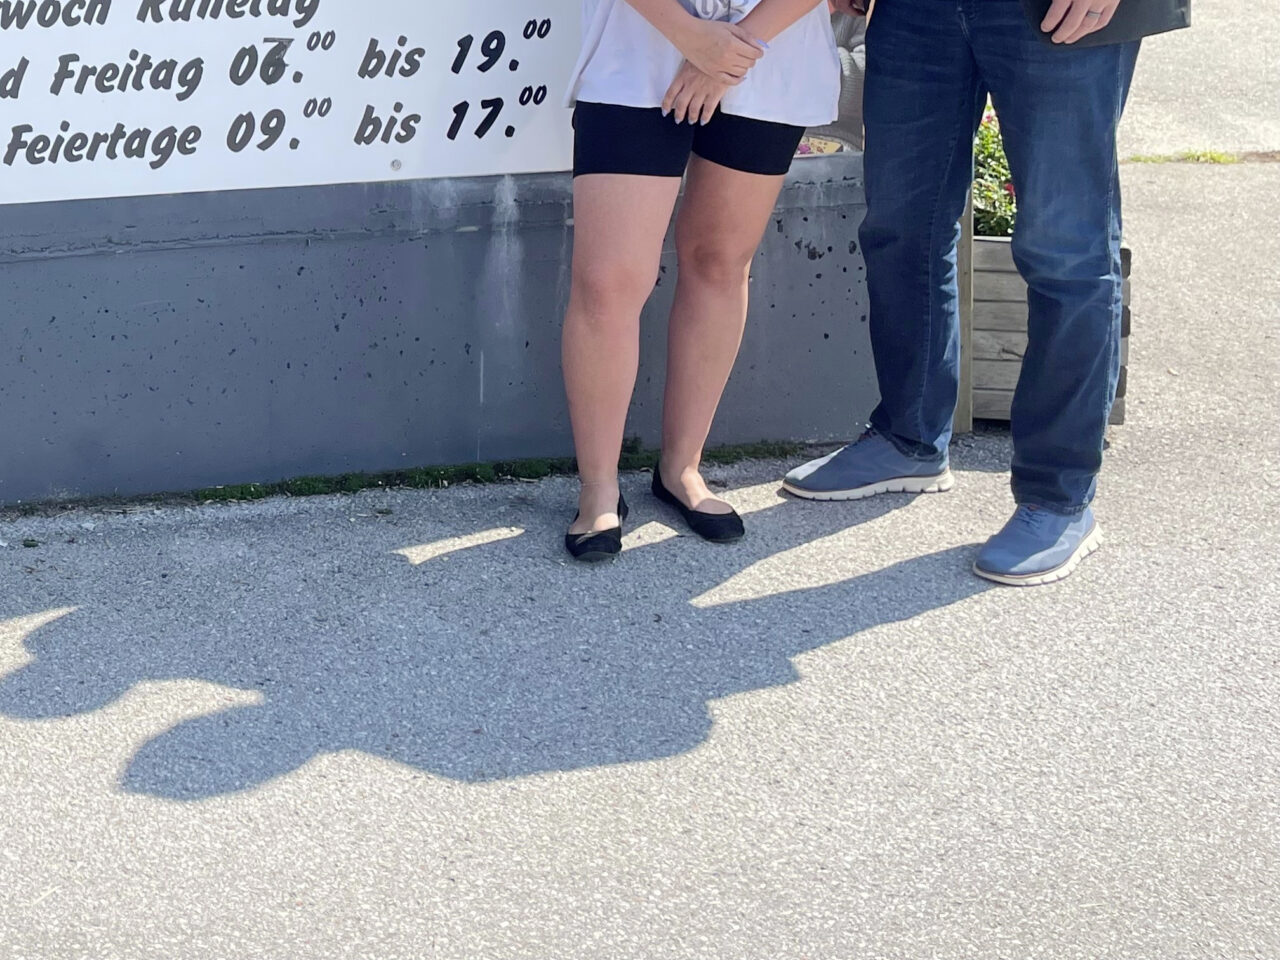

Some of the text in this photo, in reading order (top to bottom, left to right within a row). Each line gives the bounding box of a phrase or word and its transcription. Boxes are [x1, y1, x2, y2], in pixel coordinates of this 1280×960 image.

[51, 49, 205, 101] Freitag
[358, 35, 426, 79] bis
[4, 121, 202, 170] Feiertage
[354, 102, 422, 146] bis
